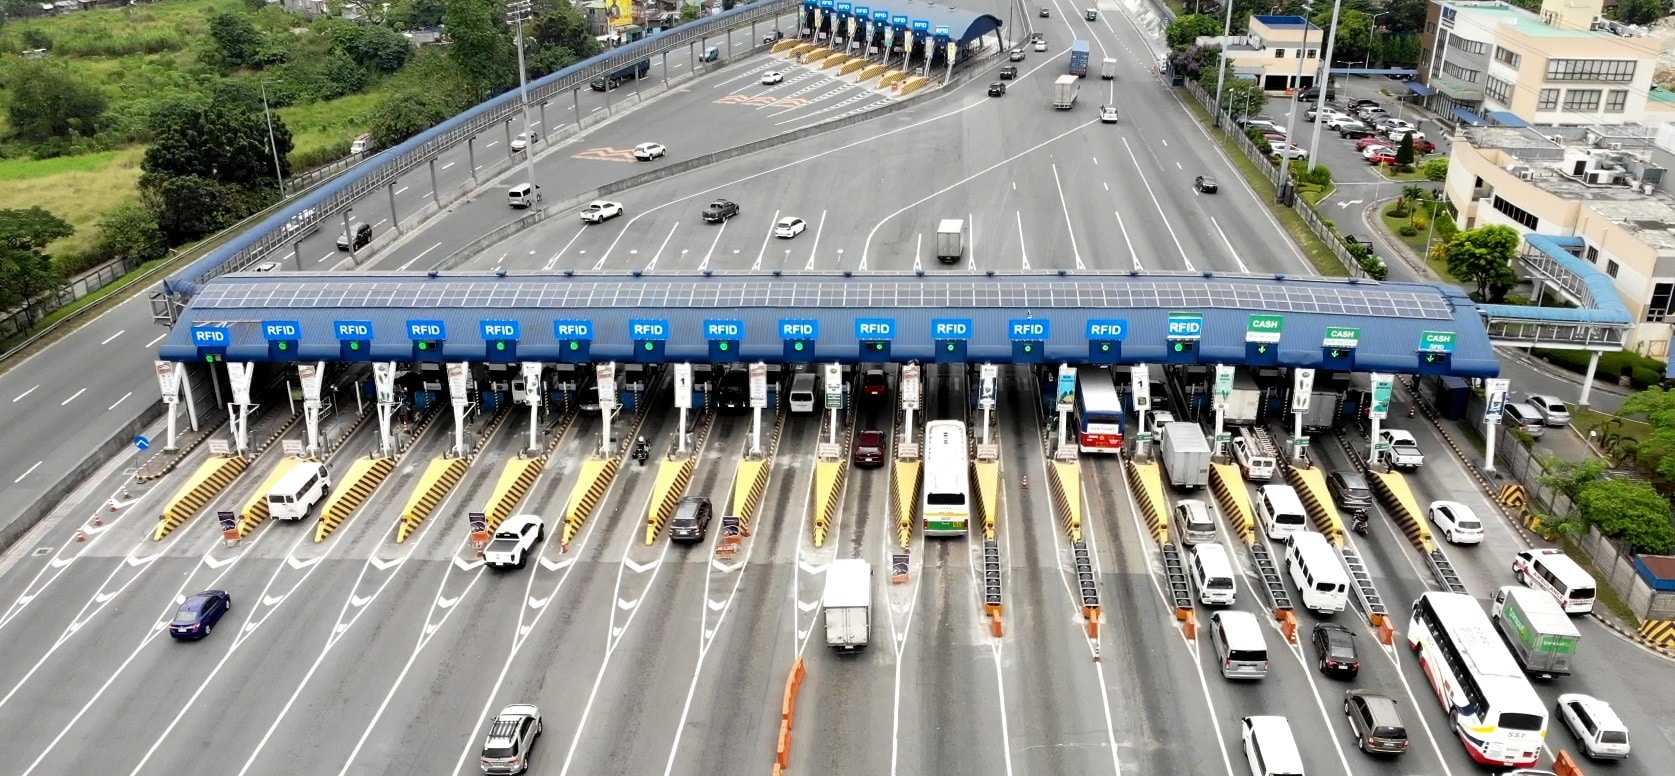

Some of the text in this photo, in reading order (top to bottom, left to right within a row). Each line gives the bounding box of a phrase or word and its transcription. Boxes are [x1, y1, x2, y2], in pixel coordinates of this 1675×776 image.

[860, 323, 890, 334] RFID
[937, 323, 967, 334] RFID
[1169, 322, 1199, 333] RFID
[1252, 320, 1278, 328] CASH
[267, 325, 295, 336] RFID
[339, 325, 367, 335] RFID
[411, 325, 440, 335] RFID
[485, 325, 514, 335] RFID
[559, 325, 588, 335] RFID
[634, 324, 663, 335] RFID
[708, 324, 738, 335] RFID
[783, 324, 813, 335] RFID
[1013, 324, 1044, 335] RFID
[1091, 325, 1121, 335] RFID
[1330, 330, 1354, 338] CASH
[196, 331, 224, 341] RFID
